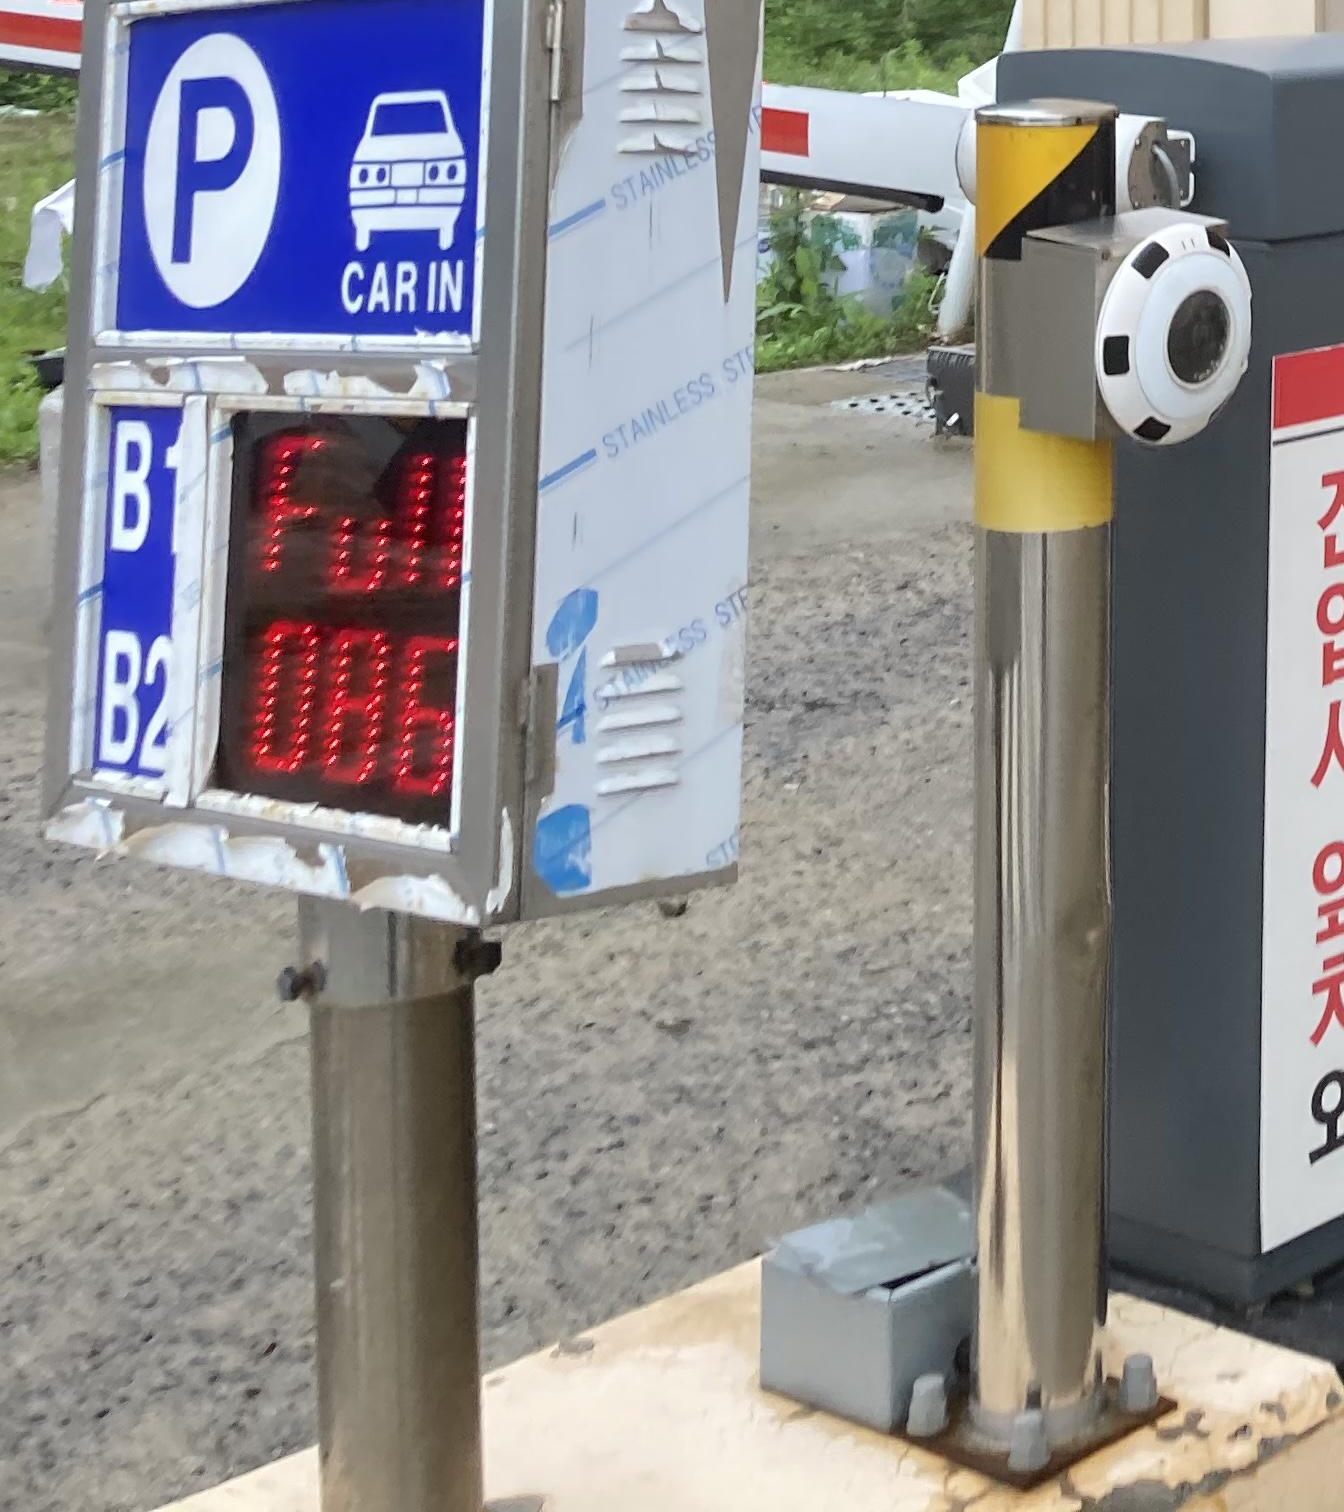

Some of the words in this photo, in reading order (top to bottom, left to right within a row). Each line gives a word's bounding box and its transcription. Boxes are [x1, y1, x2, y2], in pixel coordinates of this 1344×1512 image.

[341, 261, 416, 315] CAR
[426, 259, 465, 313] IN
[602, 372, 716, 459] STAINLESS
[98, 630, 173, 773] B2
